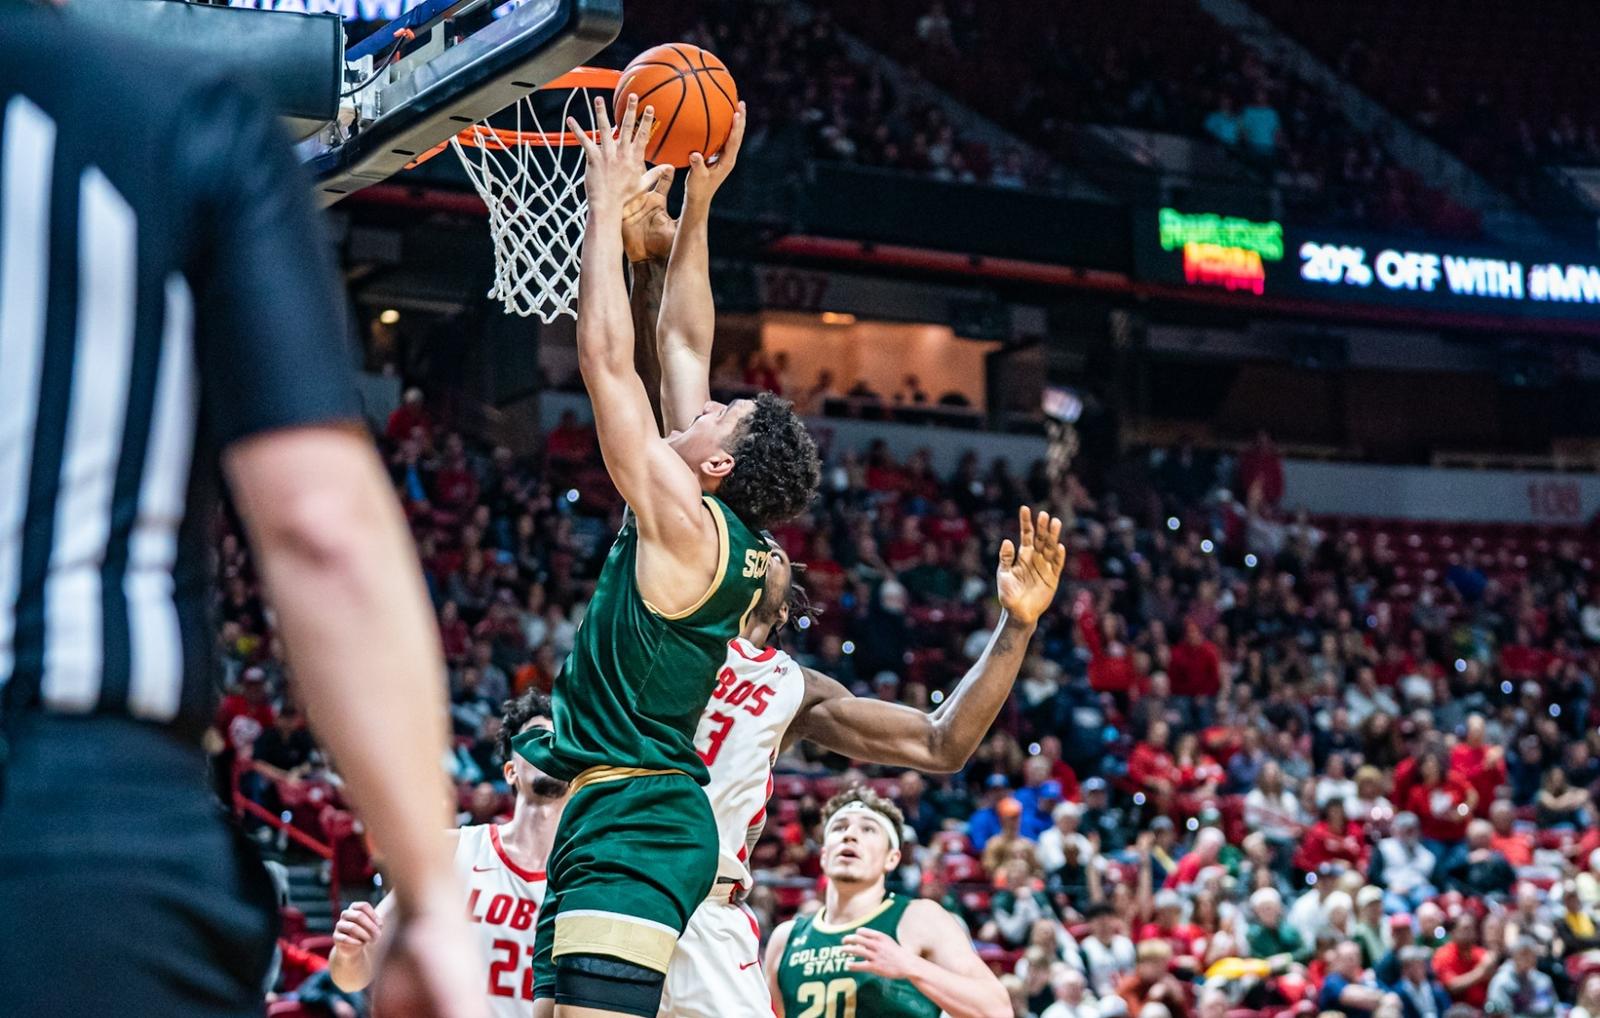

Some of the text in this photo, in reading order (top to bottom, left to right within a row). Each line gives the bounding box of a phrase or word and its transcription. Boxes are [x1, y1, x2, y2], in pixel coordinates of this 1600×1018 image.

[1299, 242, 1372, 286] 20%
[1375, 249, 1440, 291] OFF
[1443, 254, 1524, 299] WITH
[696, 710, 735, 767] 3
[465, 888, 541, 932] LOB
[788, 945, 856, 967] COLOR
[803, 956, 855, 976] STATE
[797, 977, 858, 1018] 20
